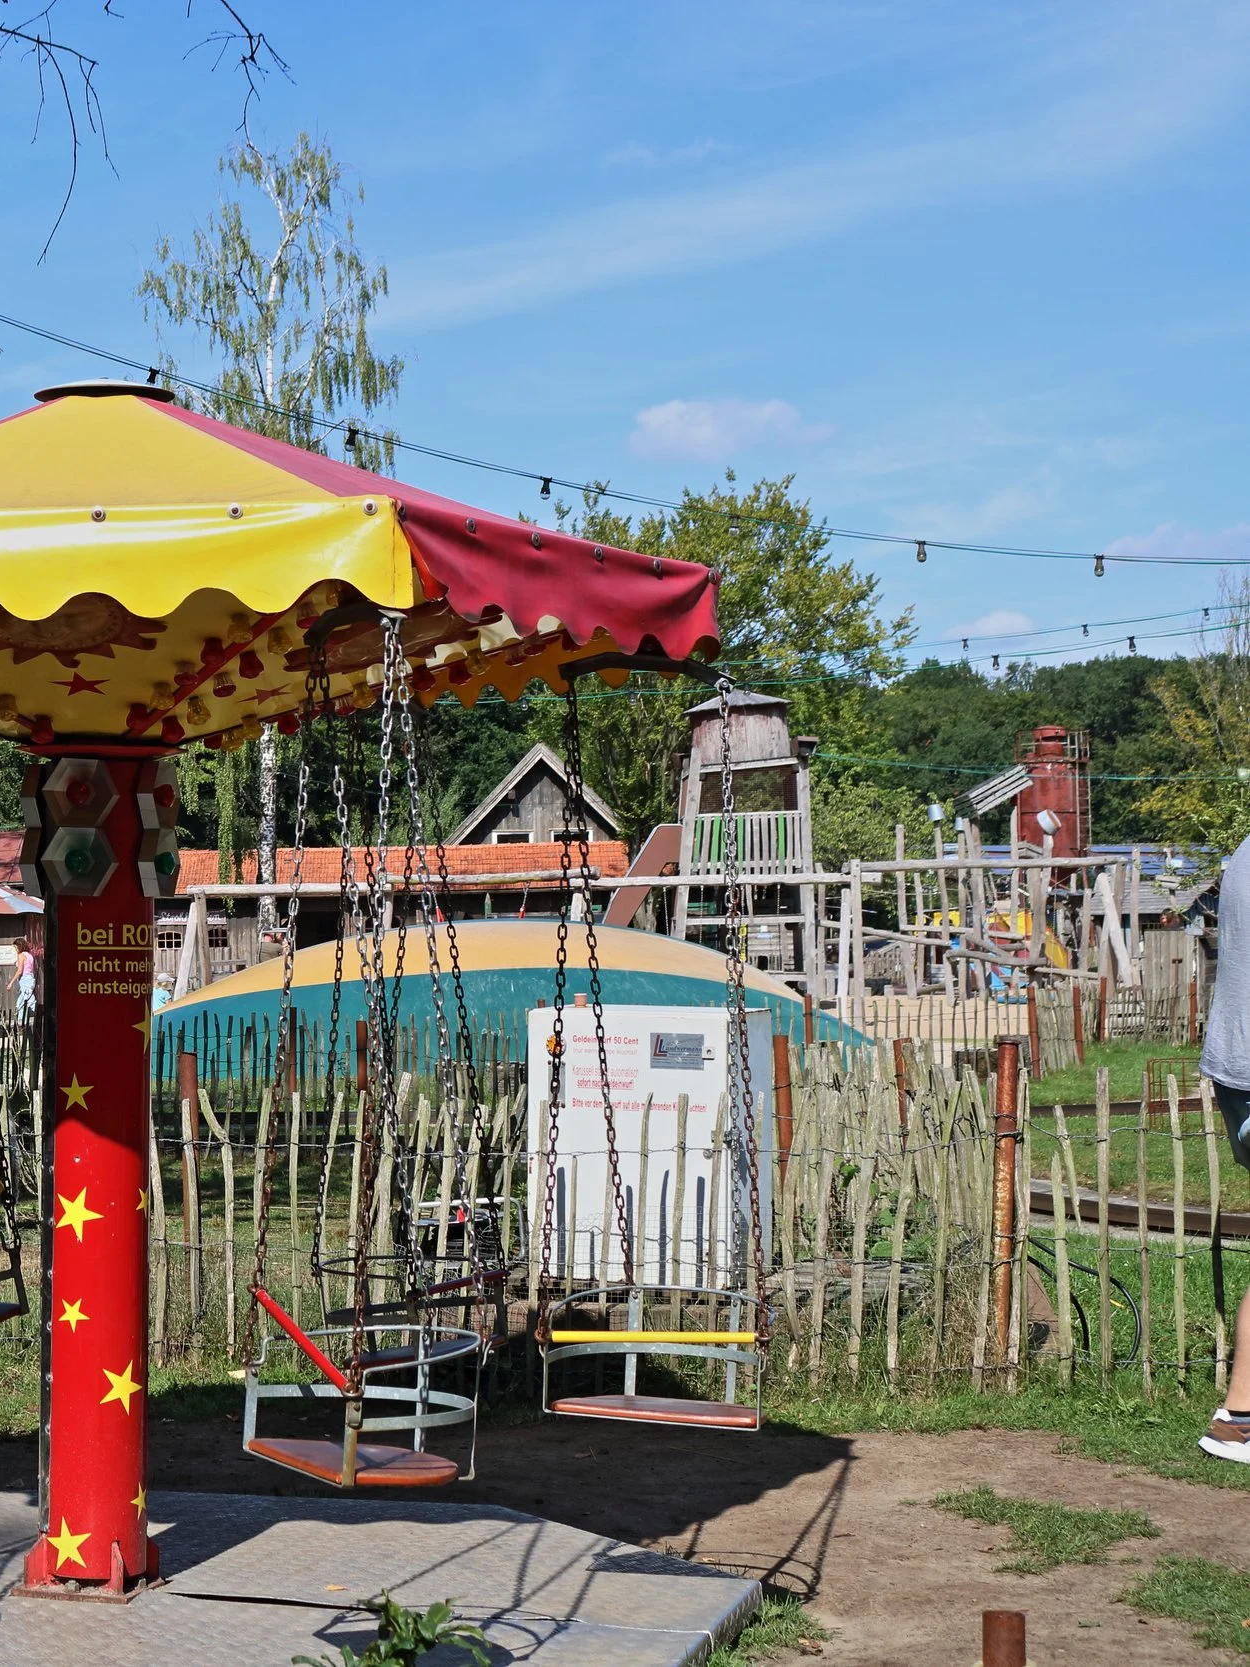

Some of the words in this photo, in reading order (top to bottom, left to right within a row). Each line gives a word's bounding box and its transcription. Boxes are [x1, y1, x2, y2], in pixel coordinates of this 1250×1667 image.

[77, 922, 113, 945] bei
[77, 956, 120, 972] nicht
[613, 1036, 622, 1044] 50
[623, 1037, 639, 1045] Cent
